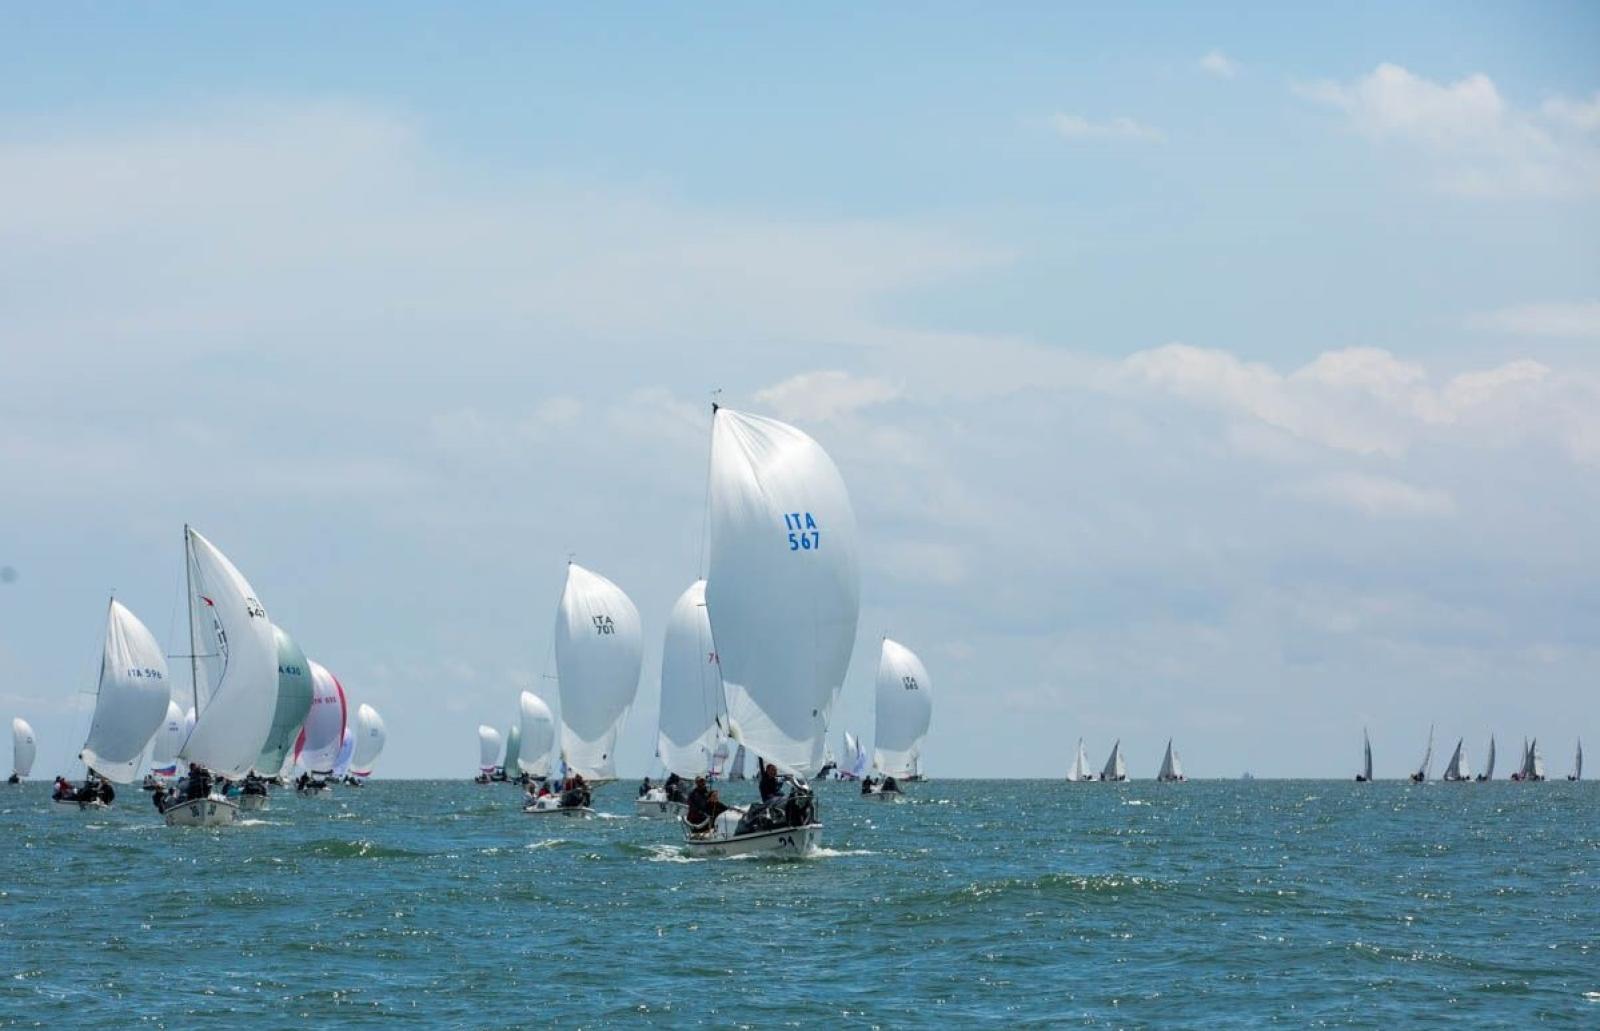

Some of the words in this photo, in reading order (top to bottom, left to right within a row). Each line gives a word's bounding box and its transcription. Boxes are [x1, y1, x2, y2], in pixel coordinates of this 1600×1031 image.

[784, 511, 817, 530] ITA
[788, 531, 819, 551] 567
[592, 615, 614, 625] ITA
[596, 625, 615, 635] 701
